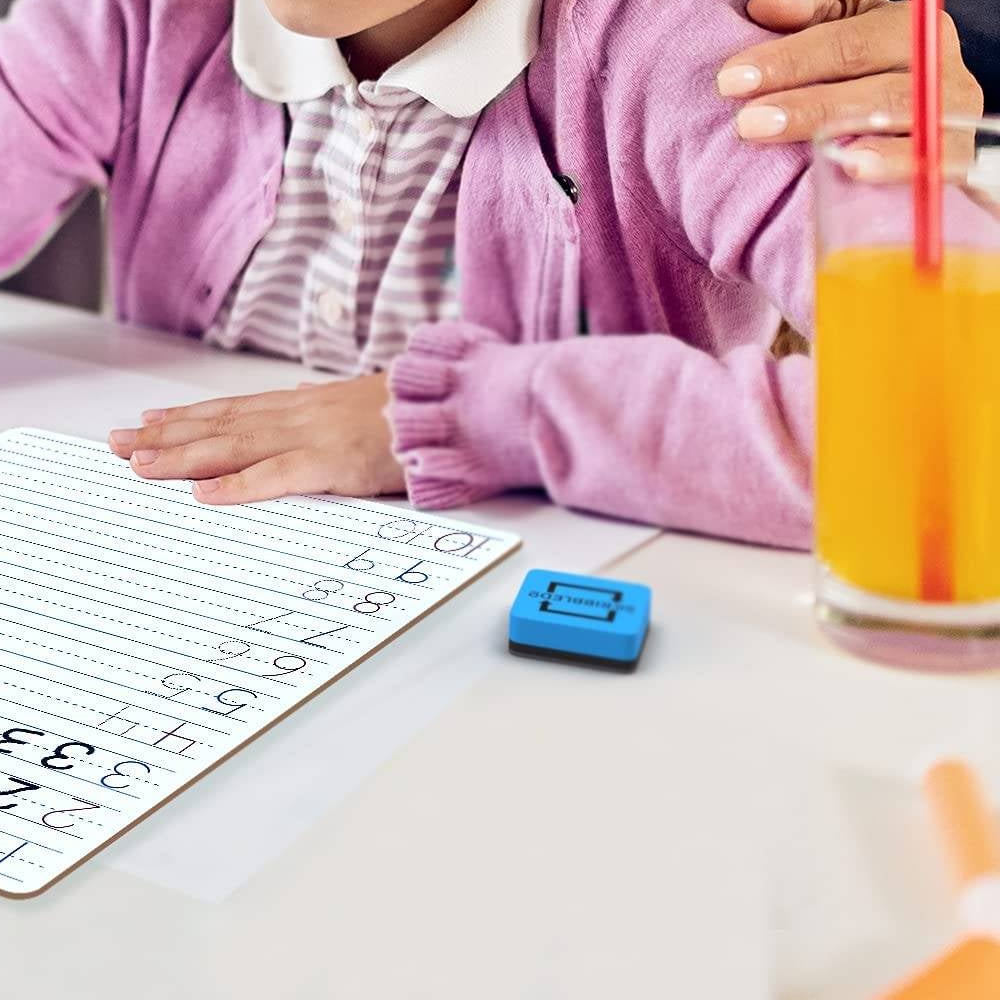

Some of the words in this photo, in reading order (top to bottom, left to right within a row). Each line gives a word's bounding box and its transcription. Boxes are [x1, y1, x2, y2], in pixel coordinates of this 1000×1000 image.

[377, 518, 432, 545] 10
[432, 531, 488, 557] 10
[302, 579, 344, 601] 8
[353, 590, 396, 615] 8
[245, 610, 297, 635] 7
[300, 625, 350, 649] 7
[206, 640, 251, 662] 6
[261, 655, 307, 678] 6
[144, 673, 201, 700] 5
[201, 687, 258, 717] 5
[96, 705, 139, 737] 4
[152, 723, 197, 755] 4
[40, 740, 96, 771] 3
[100, 760, 151, 790] 3
[42, 798, 100, 830] 2
